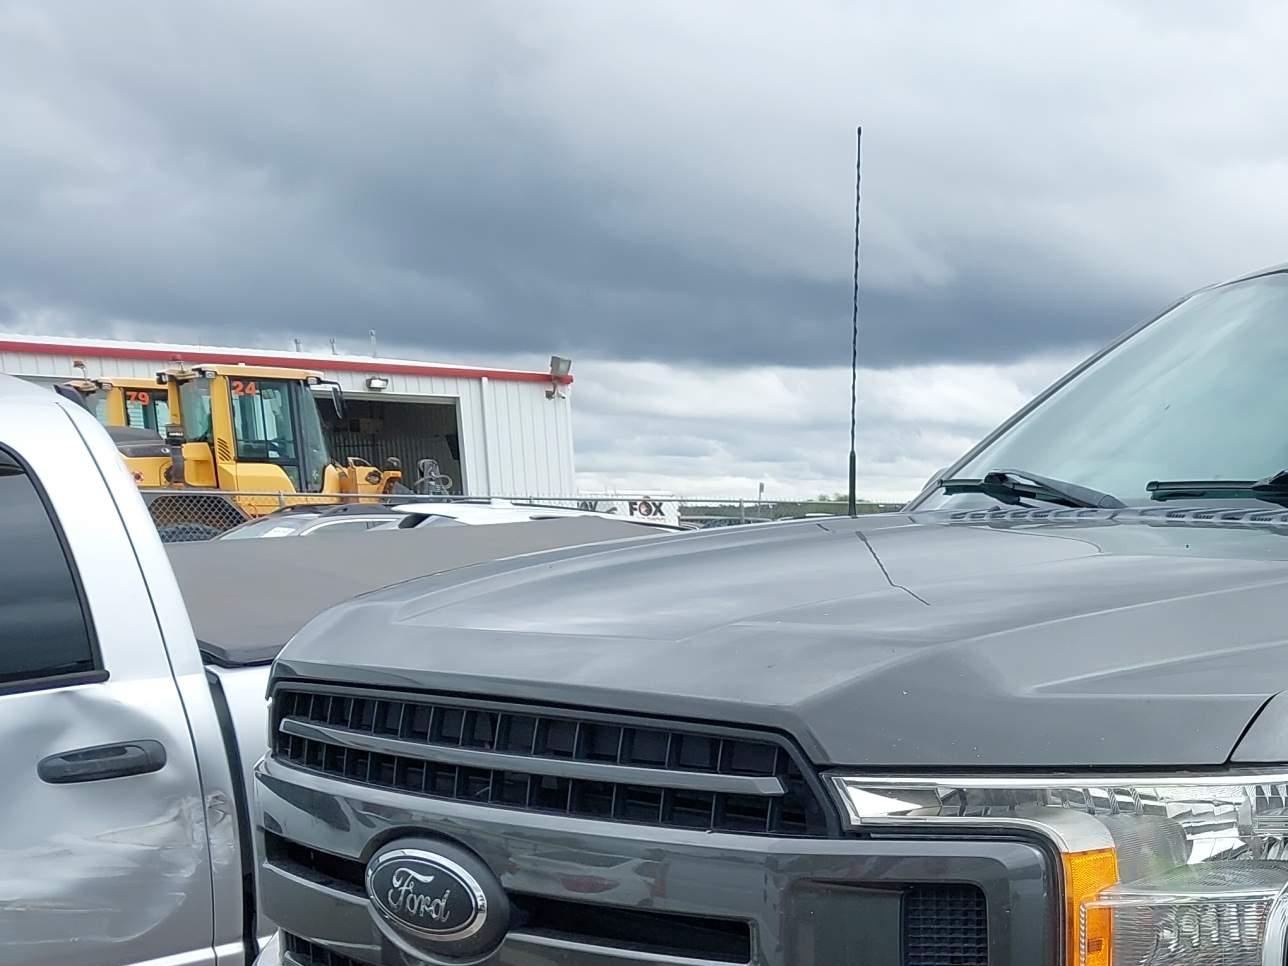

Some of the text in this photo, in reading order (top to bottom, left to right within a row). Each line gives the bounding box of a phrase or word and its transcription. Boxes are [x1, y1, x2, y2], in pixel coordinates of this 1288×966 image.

[233, 381, 257, 396] 24
[127, 391, 150, 405] 79
[628, 499, 665, 516] FOX
[388, 867, 450, 922] Ford
